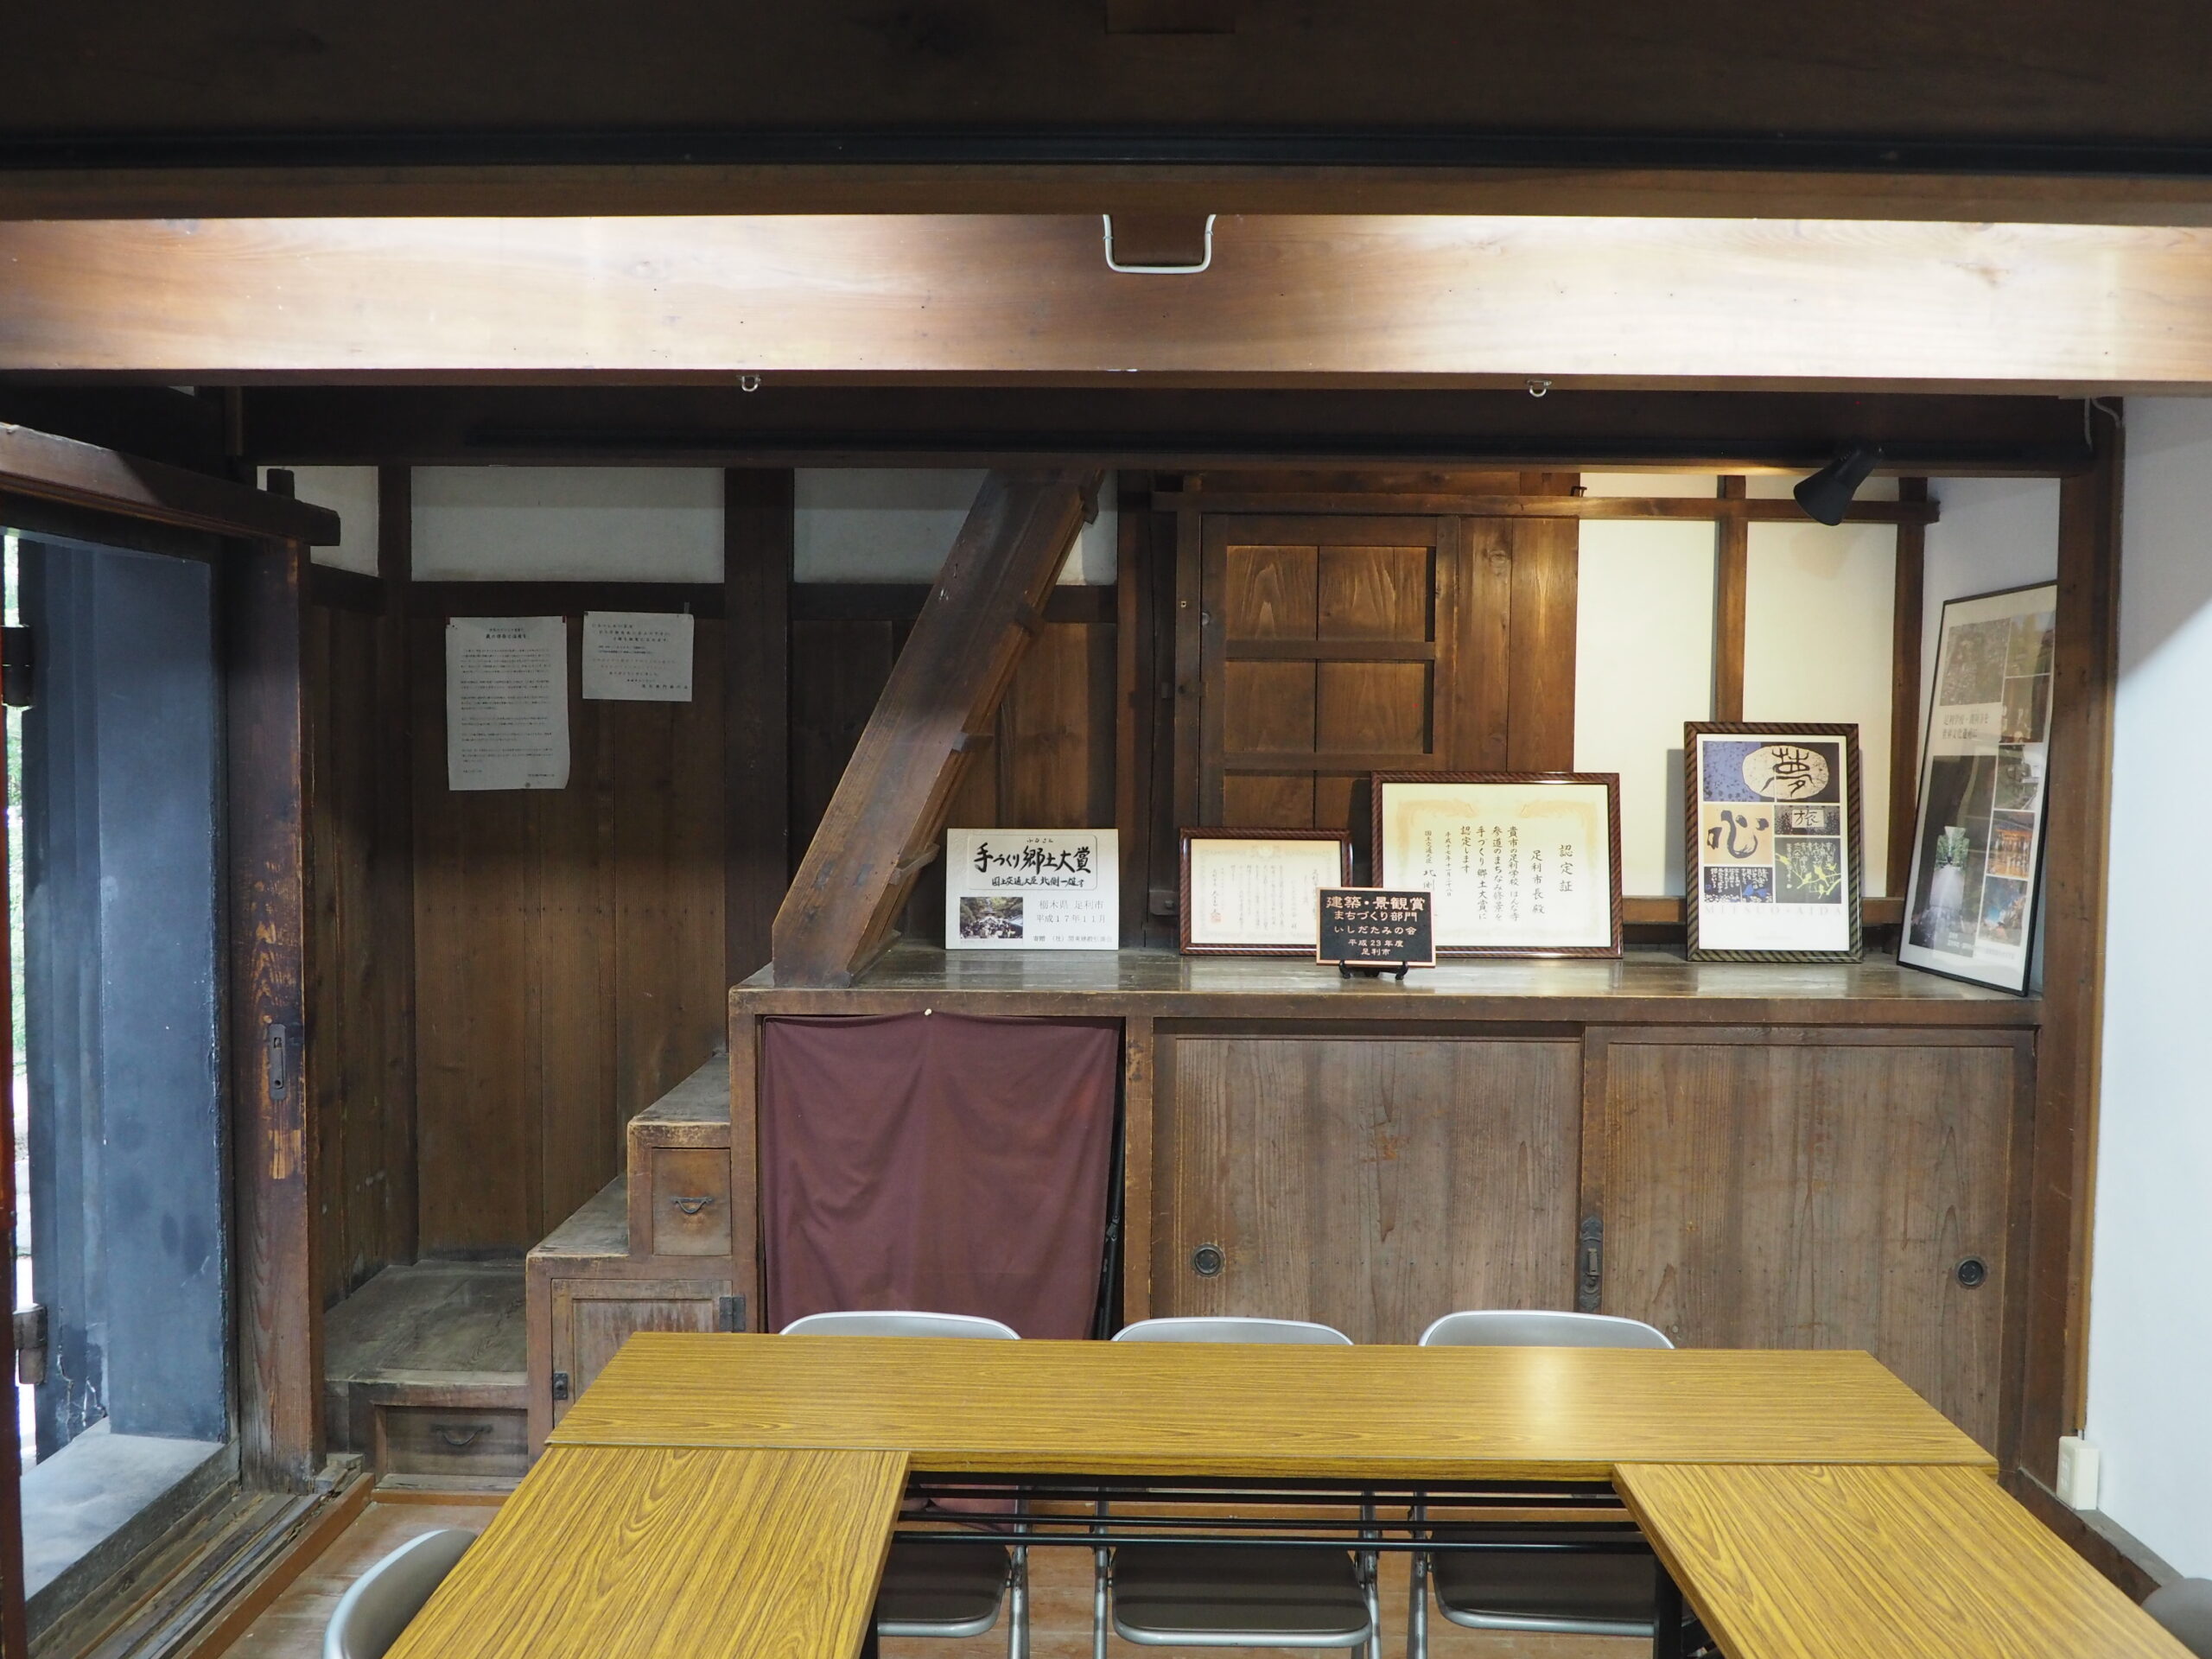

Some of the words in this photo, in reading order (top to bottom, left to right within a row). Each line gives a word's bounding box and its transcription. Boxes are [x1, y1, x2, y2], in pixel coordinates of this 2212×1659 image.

[1759, 747, 1816, 798] 夢
[1793, 809, 1819, 827] 旅
[1707, 809, 1770, 860] 心
[974, 842, 1092, 874] 手づくり郷土大賞
[1459, 825, 1471, 874] 認定します
[1558, 843, 1573, 892] 認定証
[1529, 849, 1545, 914] 足利市長殿
[1039, 899, 1068, 910] 栃木県
[1074, 899, 1104, 910] 足利市
[1325, 895, 1426, 911] 建築・景観賞
[1334, 910, 1418, 923] まちづくり部門
[1334, 925, 1417, 935] いしだたみの会
[1348, 939, 1404, 948] 平成23年度
[1361, 948, 1391, 957] 足利市
